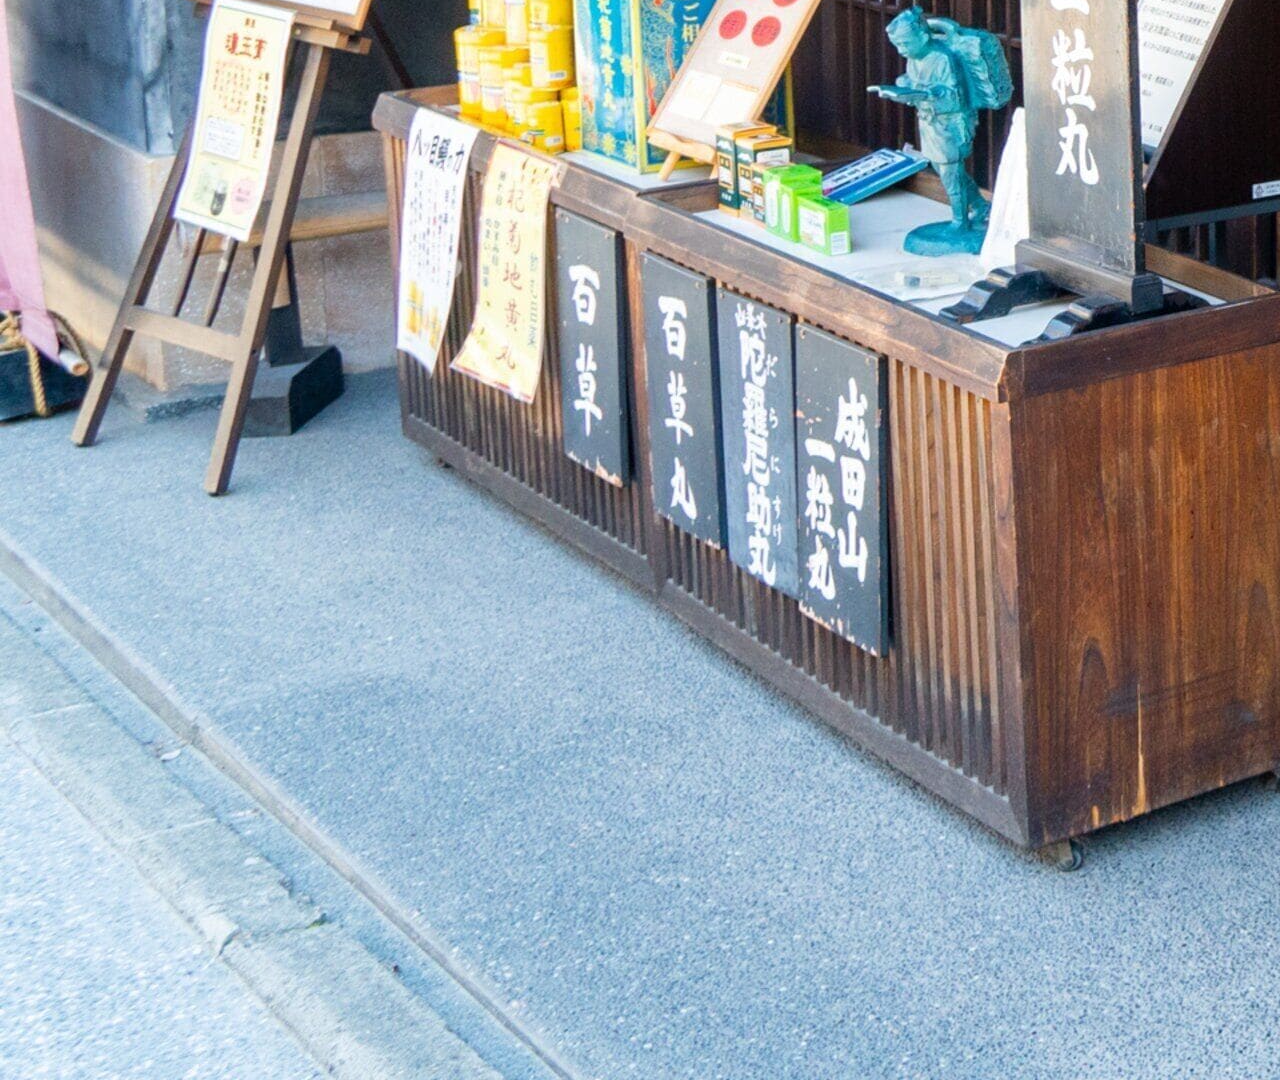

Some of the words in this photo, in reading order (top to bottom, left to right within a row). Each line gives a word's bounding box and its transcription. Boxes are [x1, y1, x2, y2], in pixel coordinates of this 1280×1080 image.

[568, 264, 602, 436] 百草
[657, 294, 698, 520] 百草丸
[766, 350, 784, 547] だらにすけ
[738, 329, 778, 586] 陀羅尼助丸
[804, 438, 837, 599] 一粒丸
[834, 377, 871, 582] 成田山
